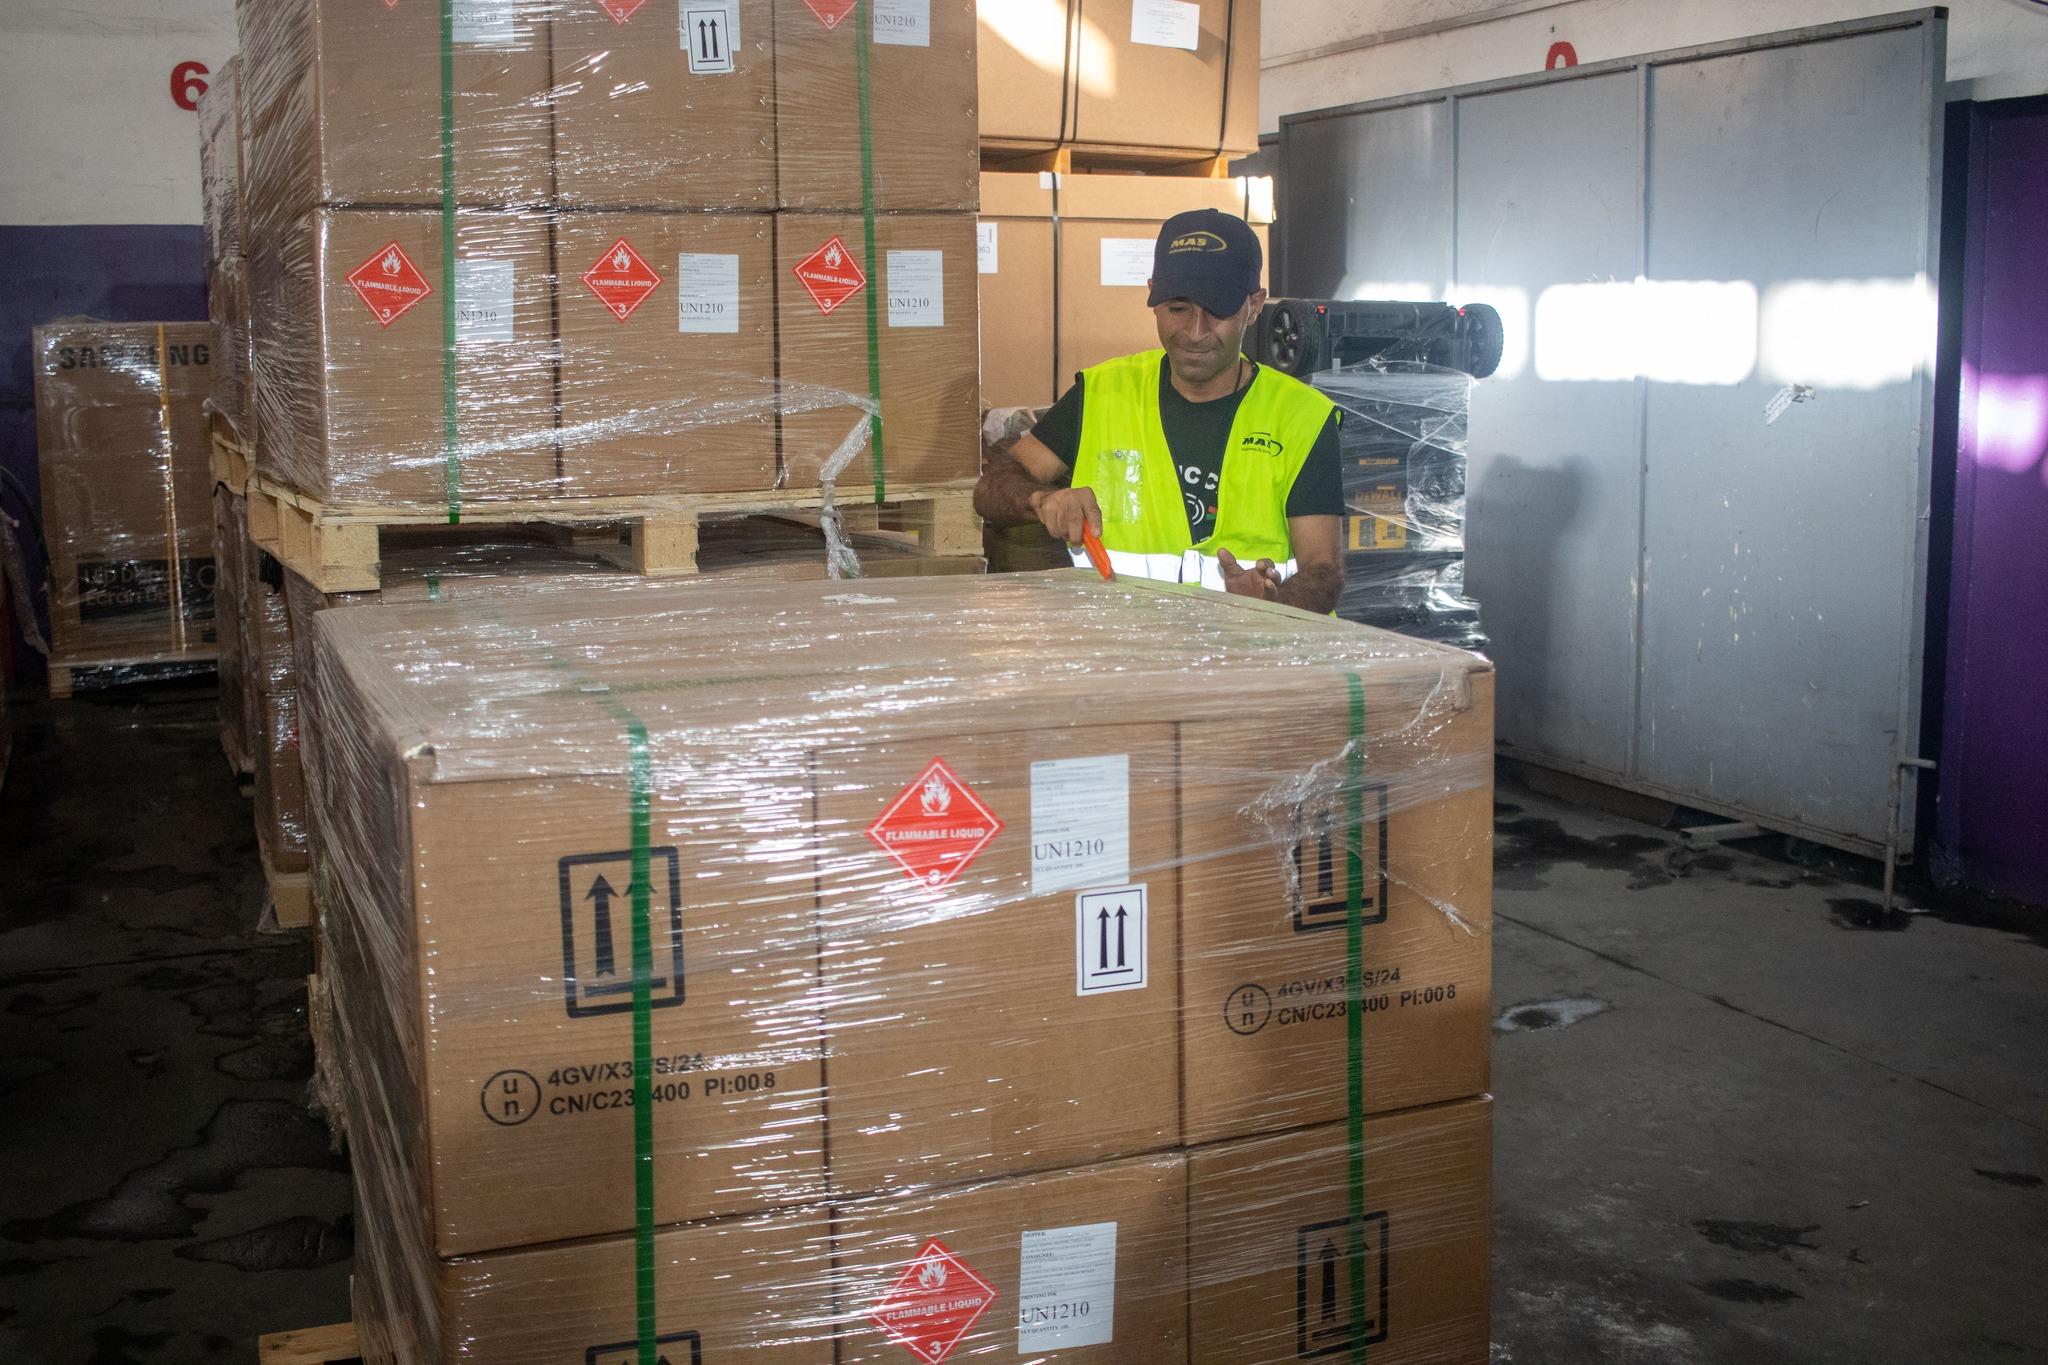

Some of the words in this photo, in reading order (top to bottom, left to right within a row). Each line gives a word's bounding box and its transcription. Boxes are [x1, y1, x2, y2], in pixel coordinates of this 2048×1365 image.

[616, 8, 624, 17] 3
[827, 15, 835, 24] 3
[875, 14, 916, 27] UN1210
[170, 61, 209, 111] 6
[803, 272, 839, 283] FLAMMABLE
[839, 277, 859, 286] LIQUID
[357, 279, 399, 293] FLAMMABLE
[399, 286, 421, 295] LIQUID
[618, 304, 626, 313] 3
[680, 303, 723, 313] UN1210
[824, 298, 832, 307] 3
[889, 298, 929, 308] UN1210
[382, 308, 391, 318] 3
[885, 829, 948, 841] FLAMMABLE
[950, 828, 985, 838] LIQUID
[1034, 838, 1104, 861] UN1210
[1278, 996, 1389, 1025] CN/C23400
[550, 1082, 690, 1115] CN/C23400
[886, 1303, 946, 1320] FLAMMABLE
[948, 1298, 982, 1310] LIQUID
[1021, 1301, 1090, 1324] UN1210
[930, 1341, 941, 1355] 3
